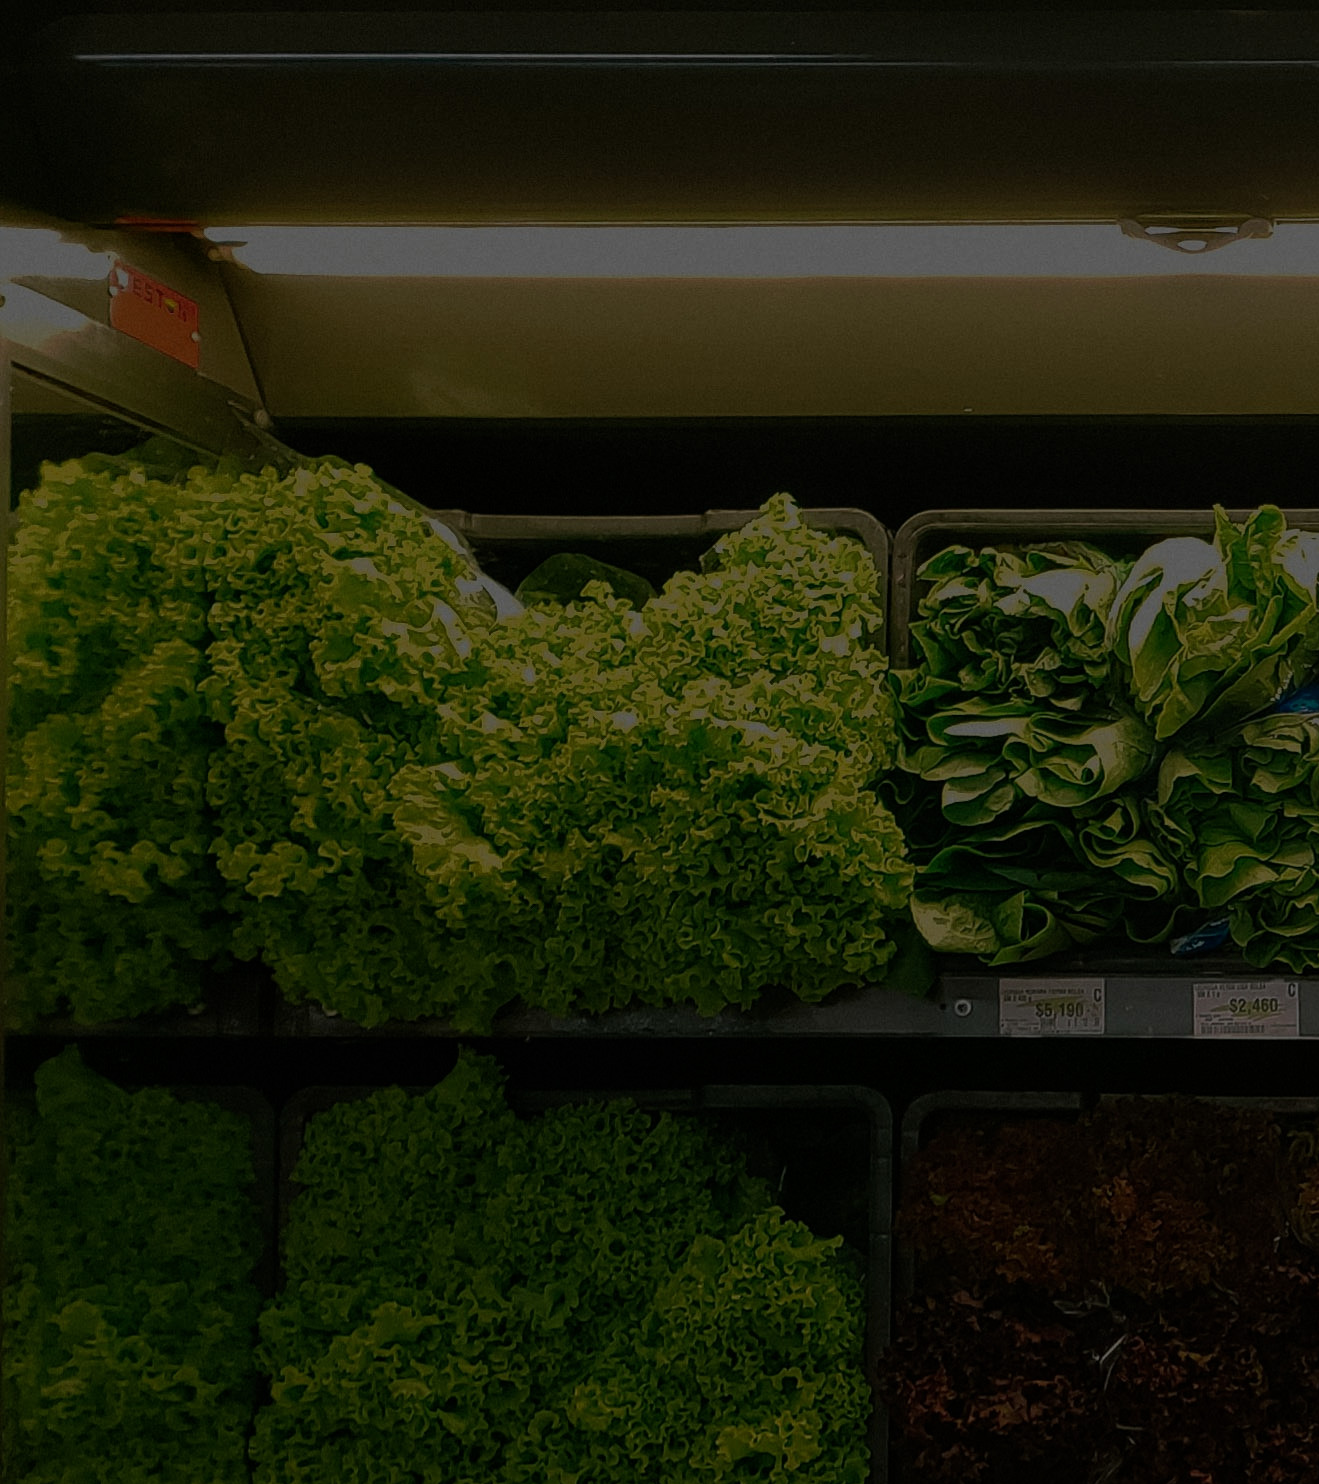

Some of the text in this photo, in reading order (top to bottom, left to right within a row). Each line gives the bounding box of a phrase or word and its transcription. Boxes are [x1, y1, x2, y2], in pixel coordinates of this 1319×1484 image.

[1093, 988, 1101, 1002] C
[1288, 984, 1296, 997] C
[1035, 1002, 1084, 1020] $5,190
[1229, 998, 1279, 1015] $2,460
